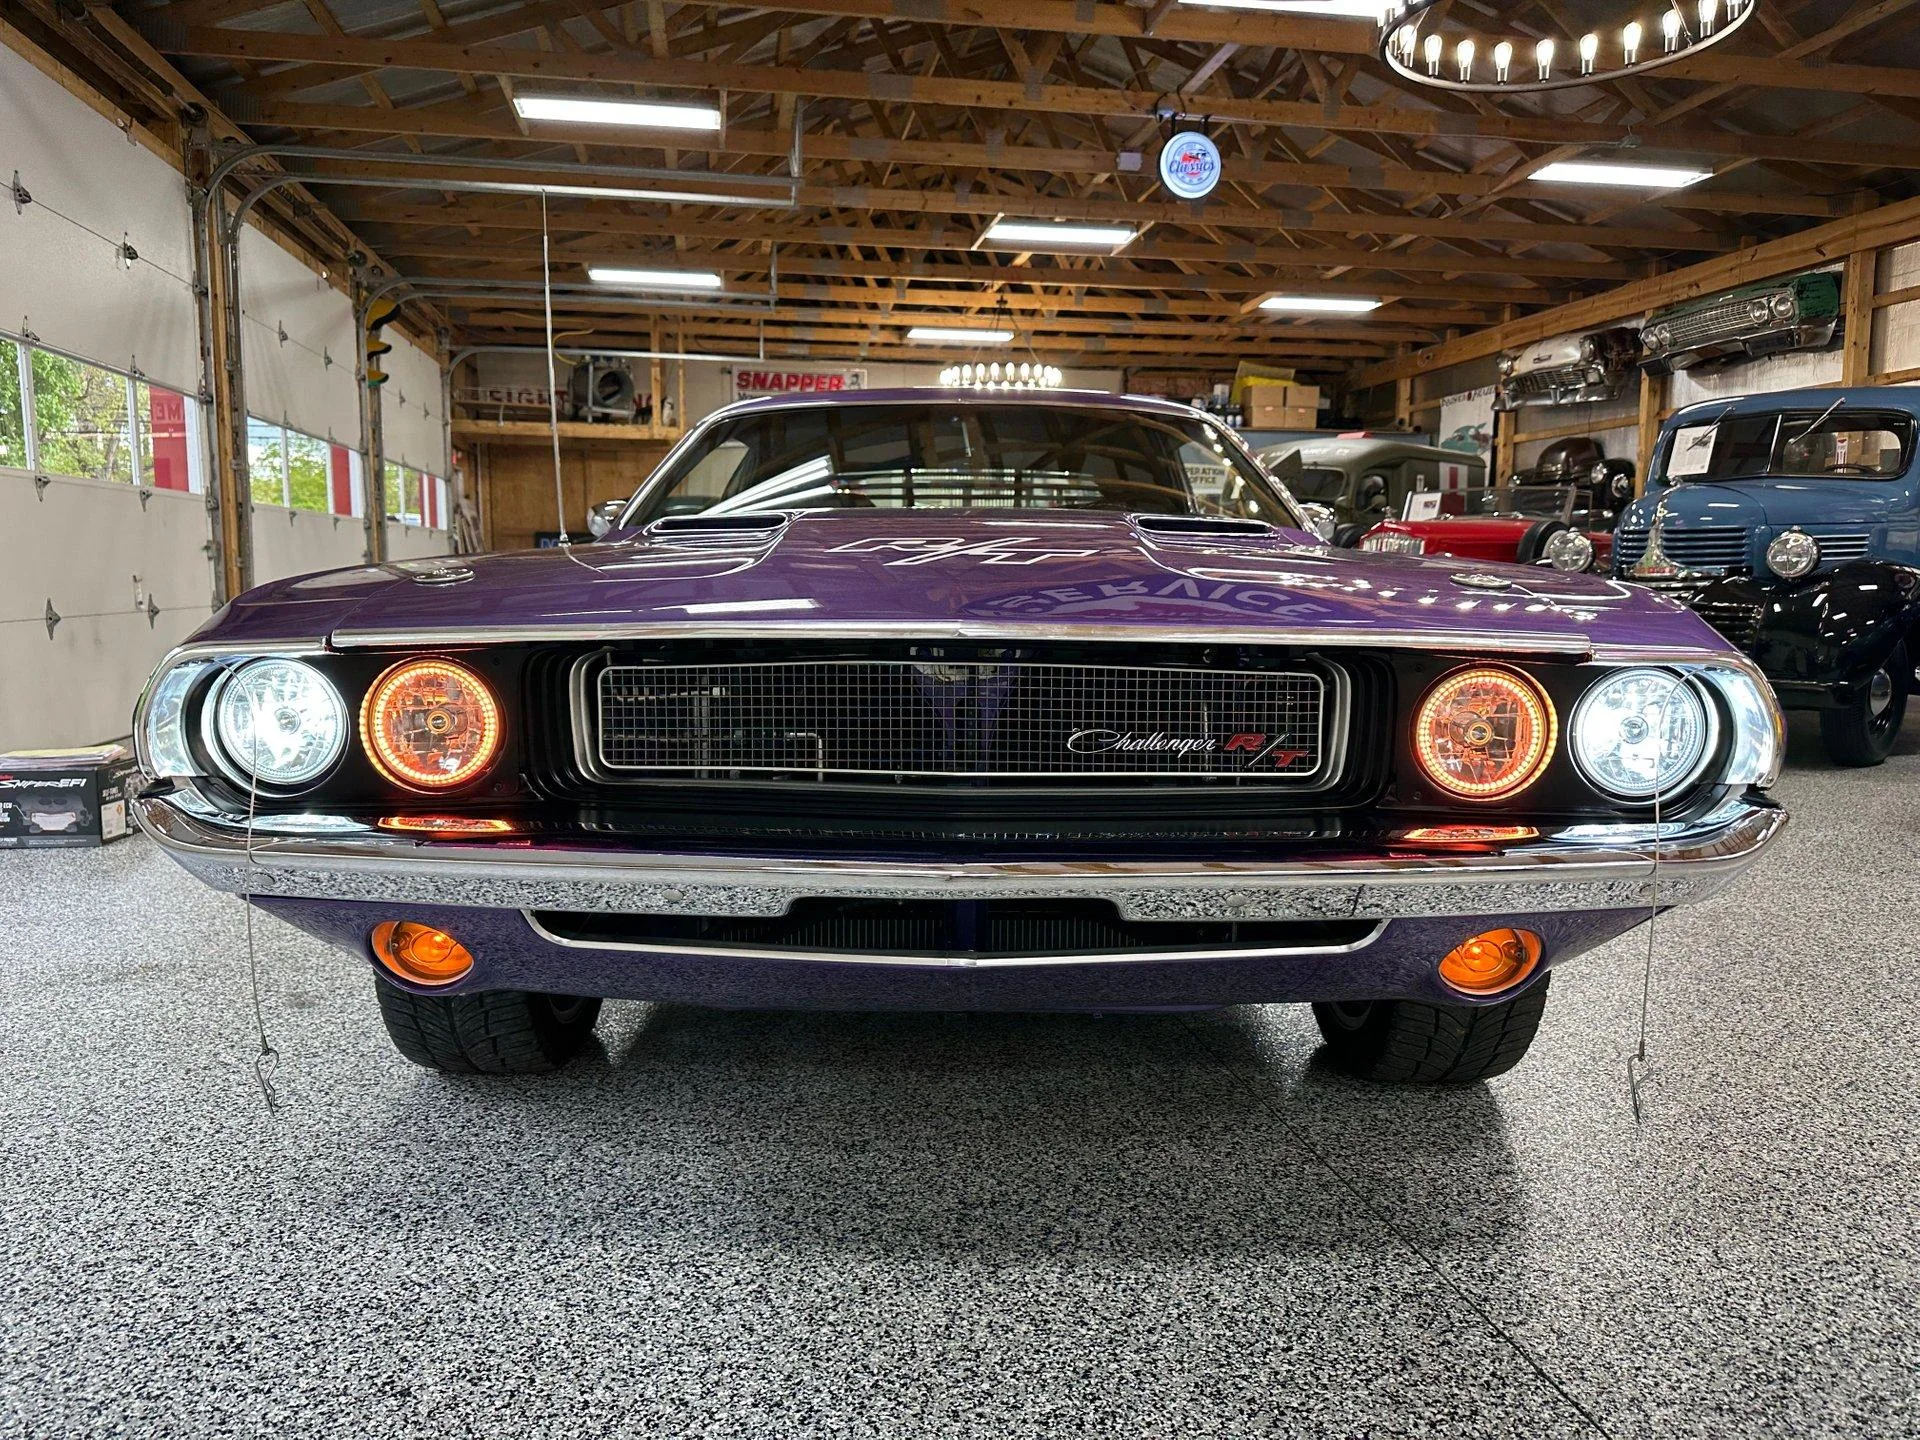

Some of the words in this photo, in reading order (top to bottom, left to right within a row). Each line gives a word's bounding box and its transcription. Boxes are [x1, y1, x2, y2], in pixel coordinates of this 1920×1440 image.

[1169, 160, 1214, 174] Classics
[736, 371, 845, 391] SNAPPER
[1185, 467, 1225, 476] PERATION
[824, 537, 1101, 566] R/T
[1067, 727, 1215, 758] Challenger
[1224, 731, 1308, 768] R/T
